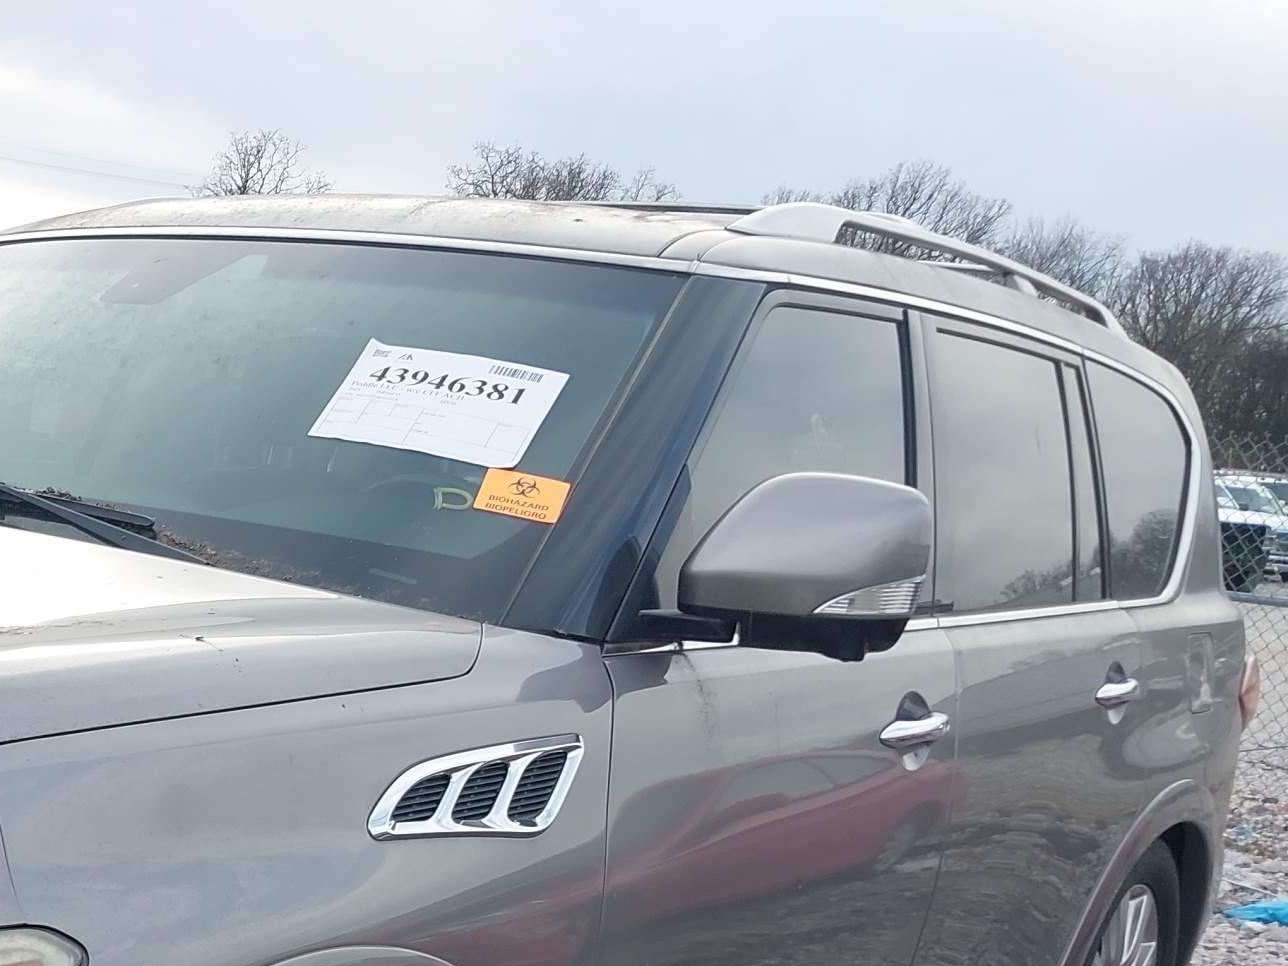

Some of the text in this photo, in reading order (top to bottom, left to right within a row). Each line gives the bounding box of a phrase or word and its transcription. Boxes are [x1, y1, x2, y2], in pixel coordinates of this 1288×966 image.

[369, 366, 527, 405] 43946381
[485, 502, 547, 520] BIOPELIGRO
[488, 494, 550, 512] BIOHAZARD
